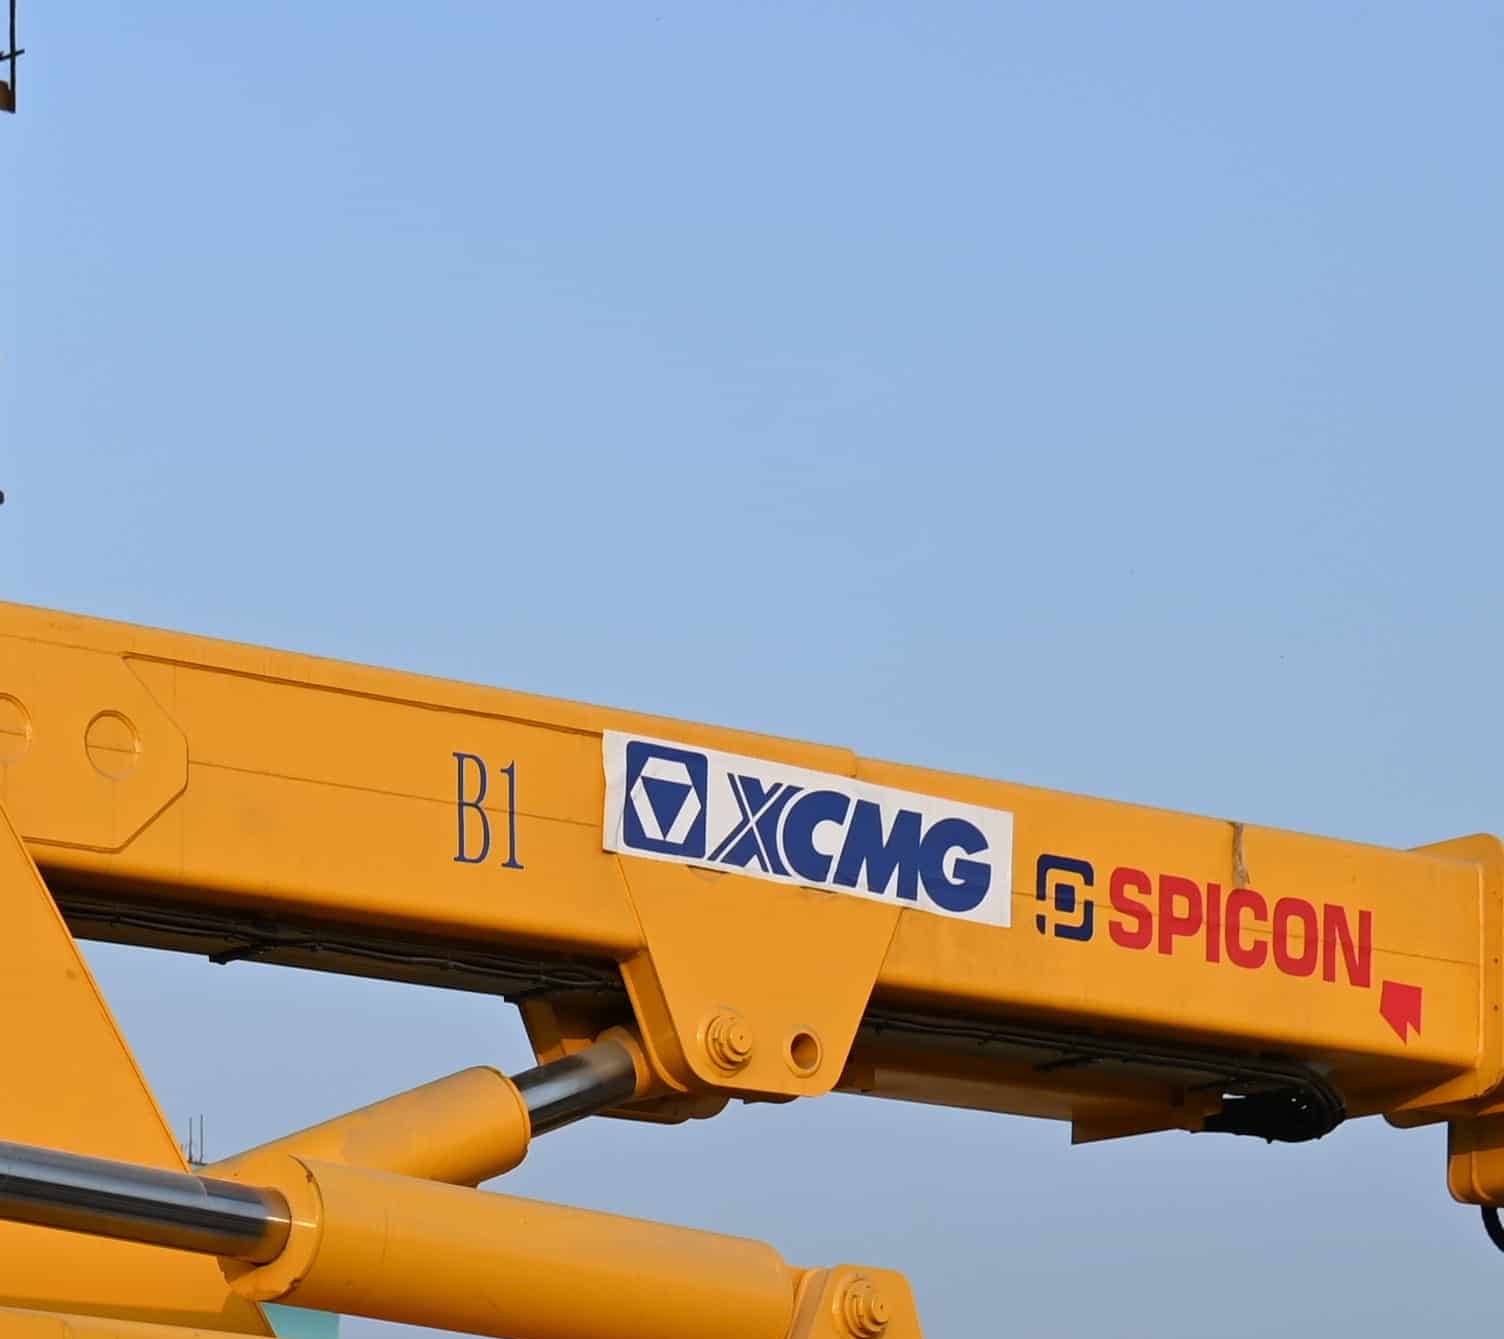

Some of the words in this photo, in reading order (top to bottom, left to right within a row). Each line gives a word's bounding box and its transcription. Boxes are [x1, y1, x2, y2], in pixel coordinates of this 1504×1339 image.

[453, 751, 524, 870] B1
[708, 773, 992, 912] XCMG
[1109, 866, 1373, 988] SPICON
